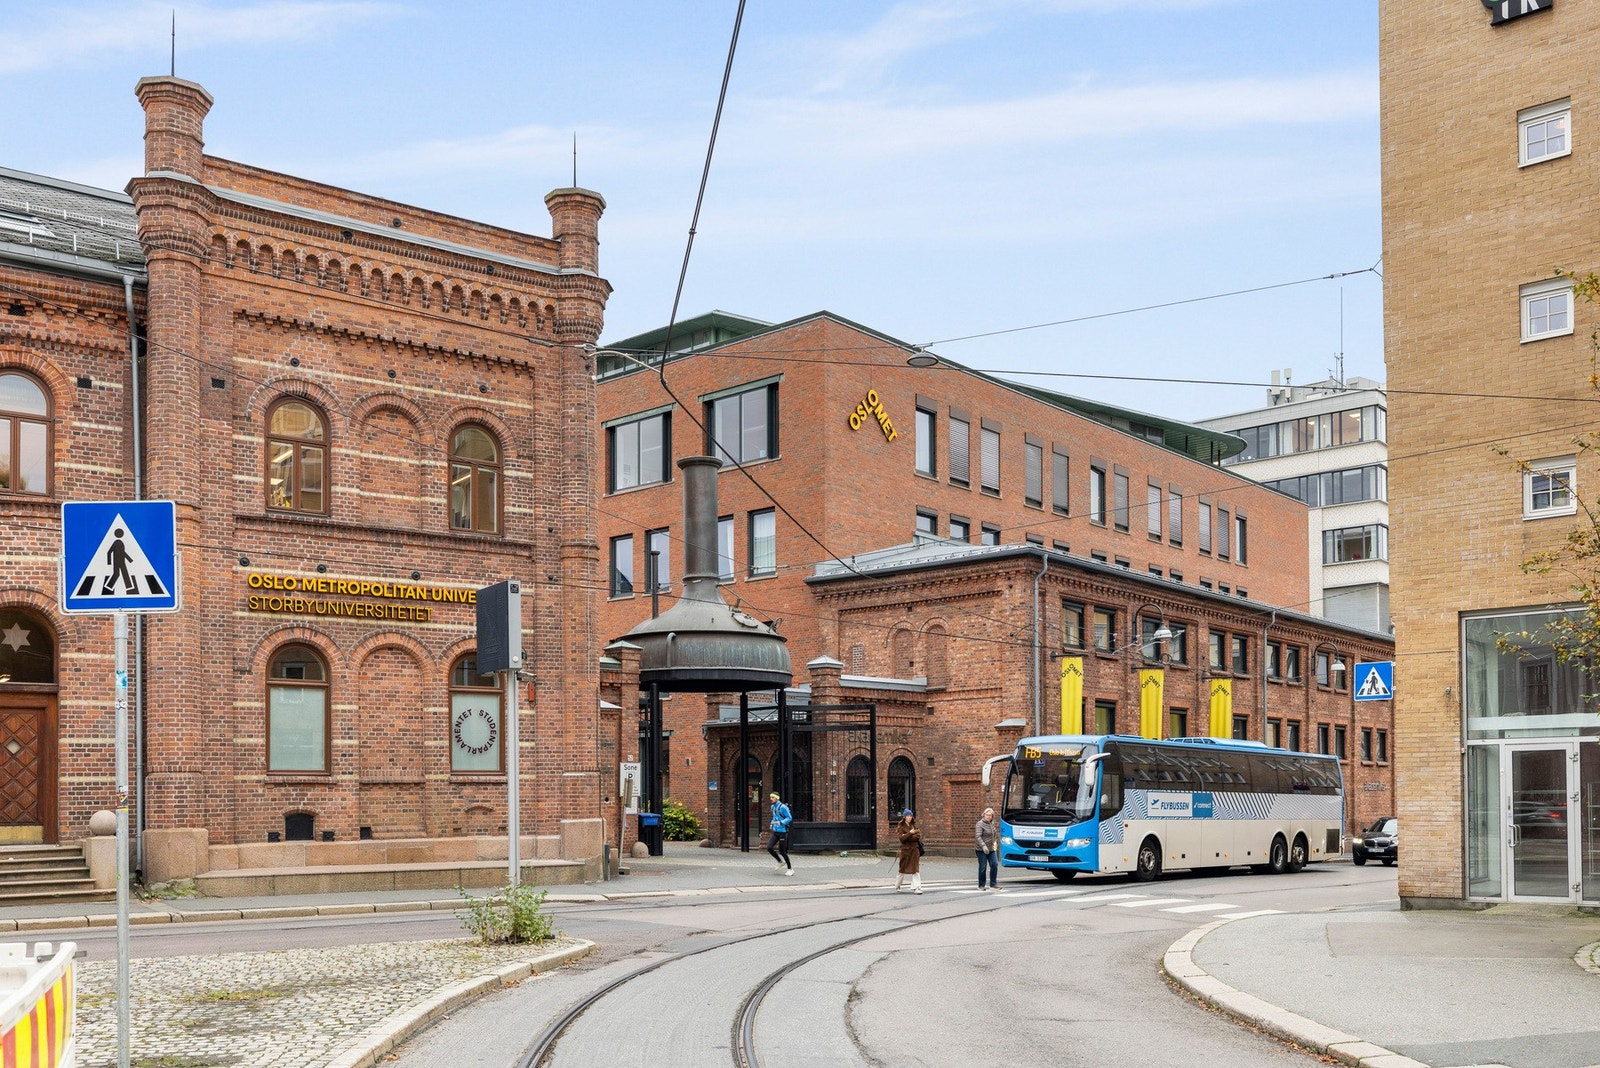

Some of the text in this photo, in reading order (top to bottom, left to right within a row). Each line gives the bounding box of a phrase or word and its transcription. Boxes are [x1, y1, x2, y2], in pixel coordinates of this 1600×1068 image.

[248, 573, 297, 590] OSLO
[302, 578, 428, 601] METROPOLITAN
[248, 595, 433, 621] STORBYUNIVERSITETET
[1061, 663, 1082, 678] OSLOMET
[1141, 675, 1161, 689] OSLOMET
[1210, 684, 1230, 697] OSLOMET
[454, 708, 497, 755] STUDENTPARLAMENTET
[848, 729, 909, 744] akaemika
[1025, 747, 1042, 759] FB5
[1160, 801, 1190, 810] FLYBUSSEN
